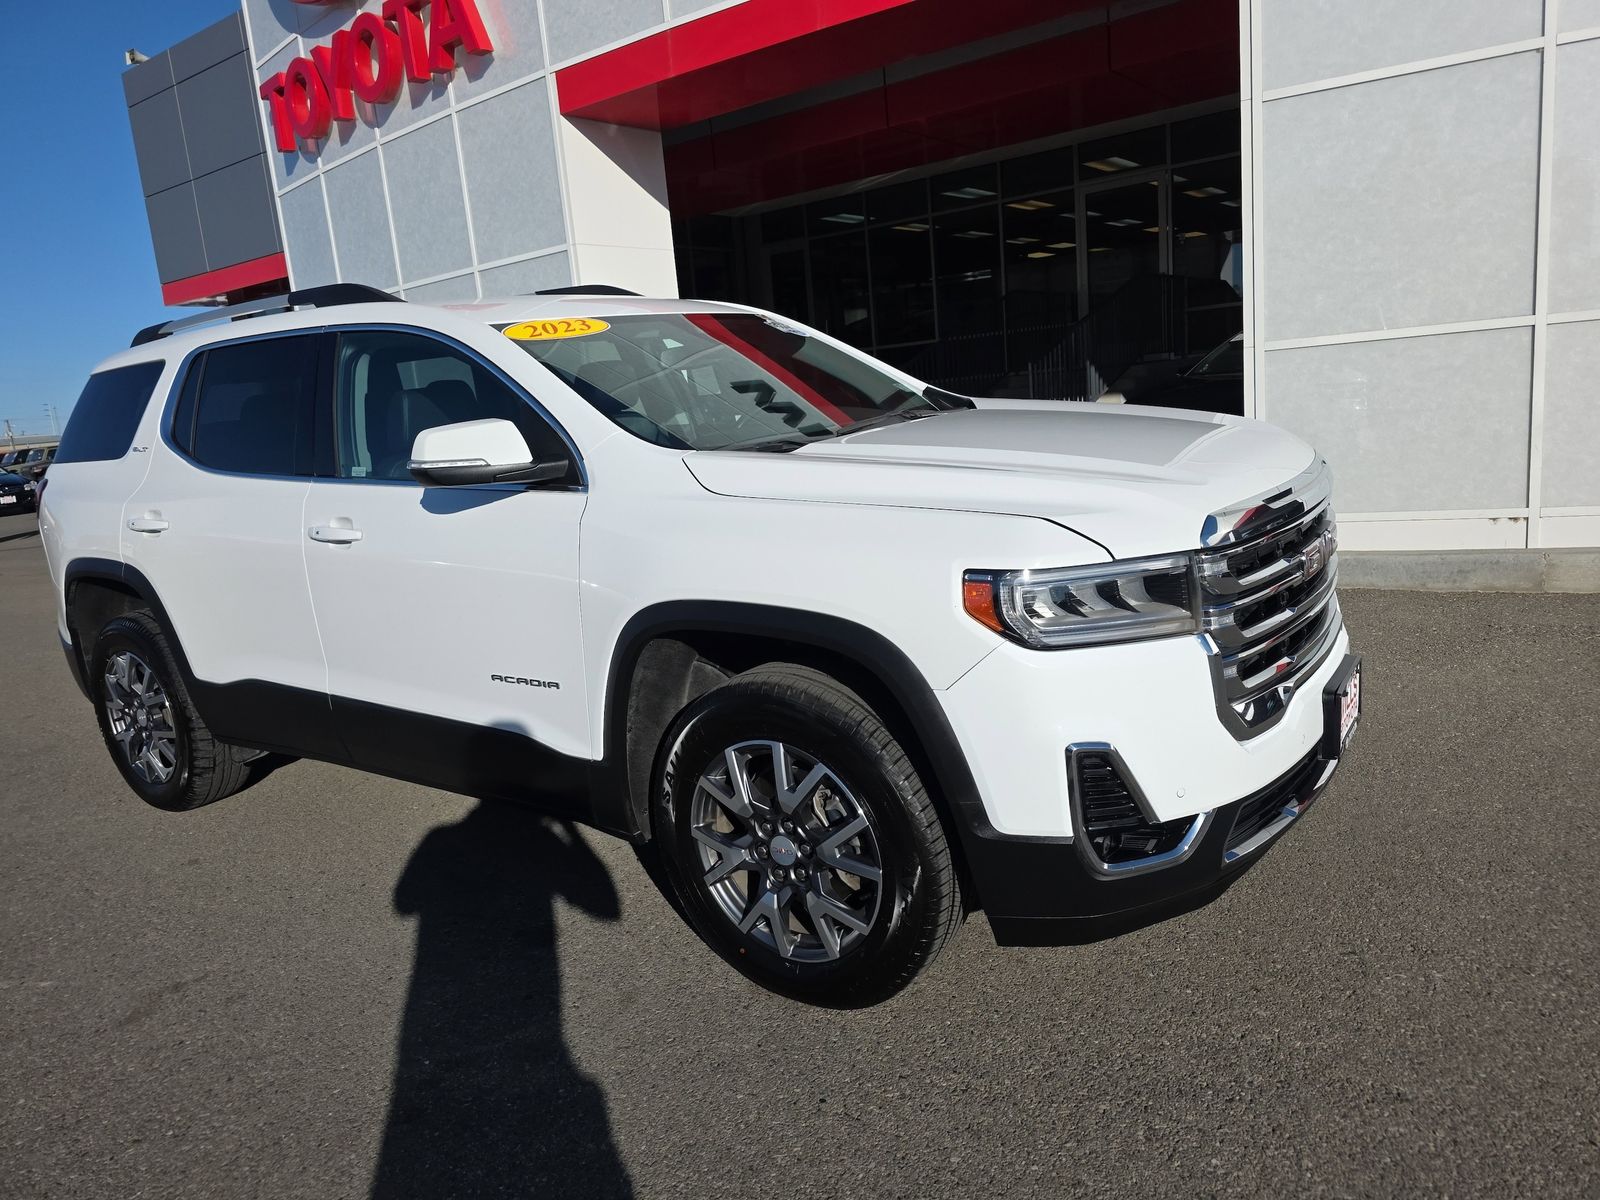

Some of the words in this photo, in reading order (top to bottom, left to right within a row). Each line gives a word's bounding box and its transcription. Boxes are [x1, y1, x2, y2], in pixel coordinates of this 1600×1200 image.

[259, 0, 494, 153] TOYOTA
[524, 319, 592, 338] 2023
[490, 673, 560, 690] ACADIA
